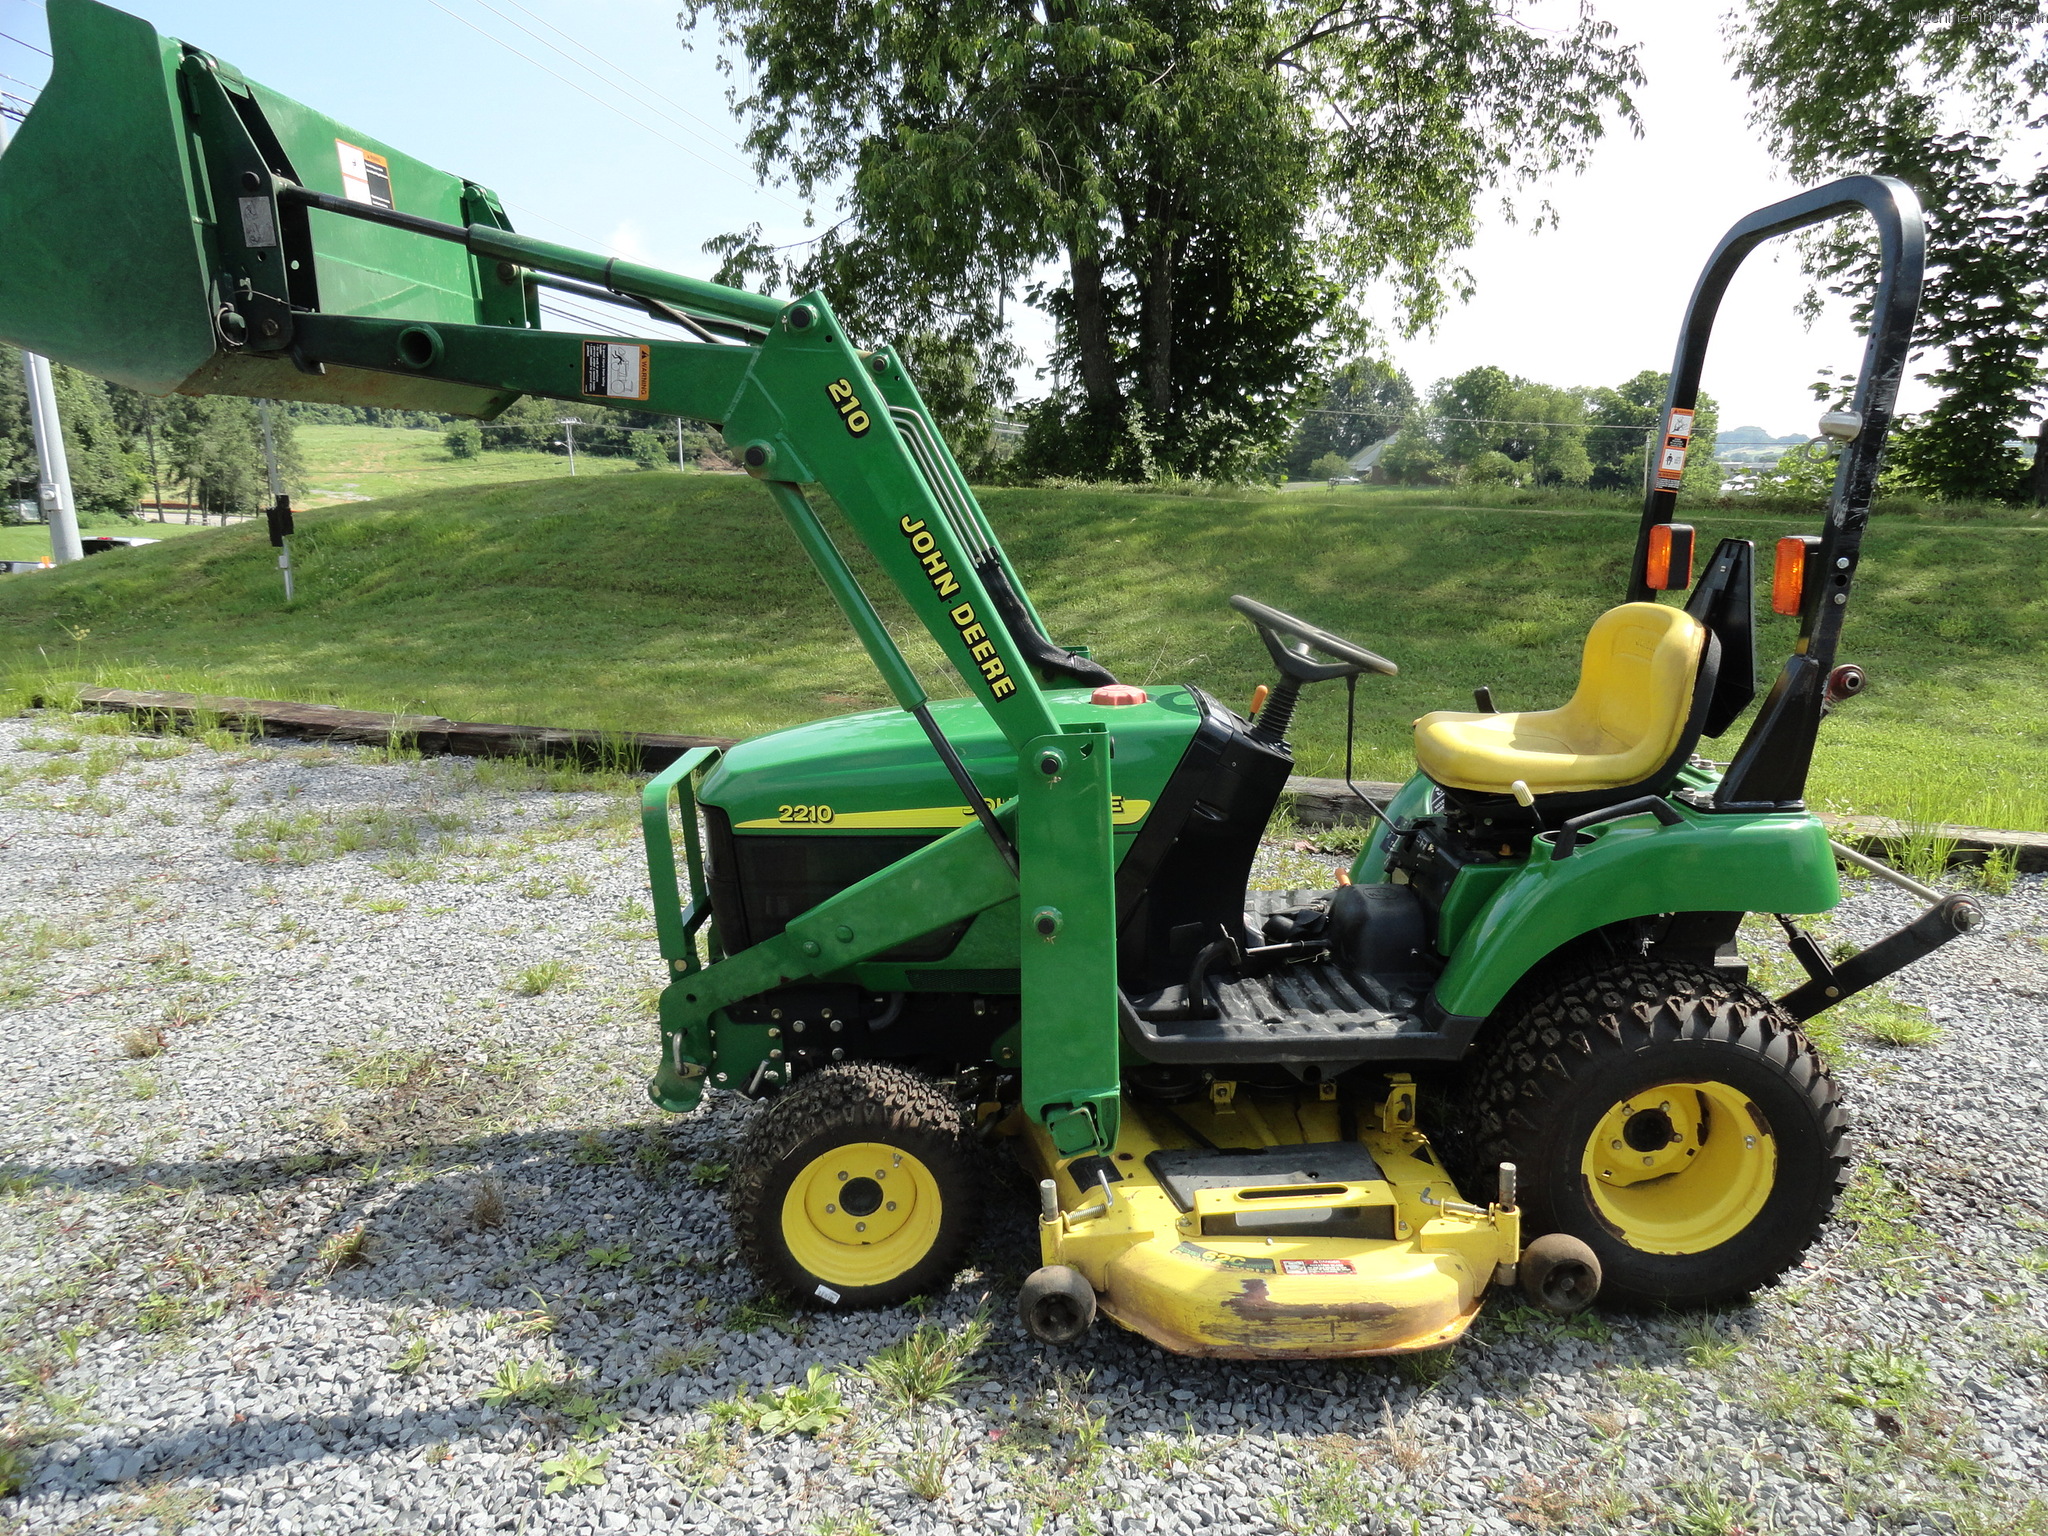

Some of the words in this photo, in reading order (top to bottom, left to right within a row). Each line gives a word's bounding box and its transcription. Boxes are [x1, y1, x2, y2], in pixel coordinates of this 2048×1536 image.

[640, 361, 648, 395] WARNING
[825, 378, 871, 437] 210
[900, 514, 961, 601] JOHN
[949, 601, 1016, 702] DEERE
[778, 804, 834, 823] 2210
[1202, 1250, 1247, 1266] 62C
